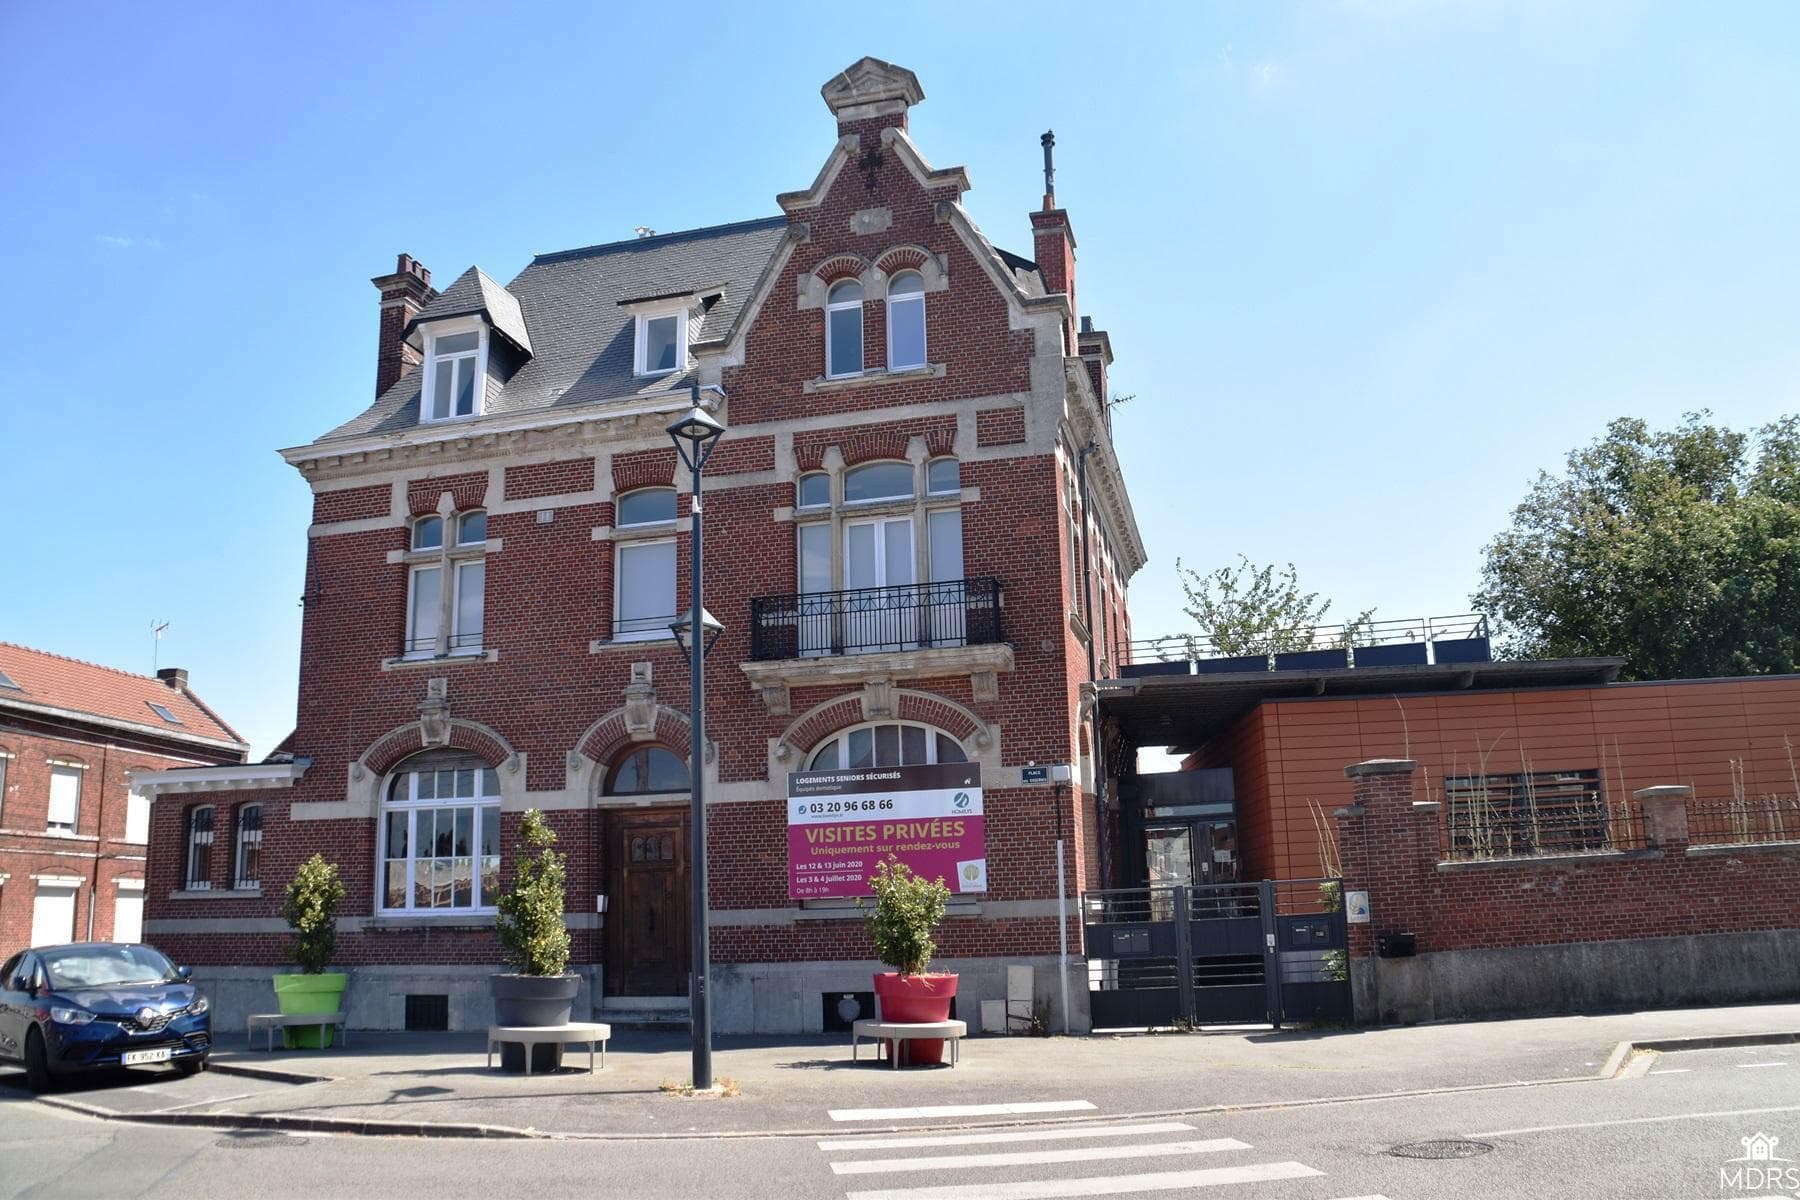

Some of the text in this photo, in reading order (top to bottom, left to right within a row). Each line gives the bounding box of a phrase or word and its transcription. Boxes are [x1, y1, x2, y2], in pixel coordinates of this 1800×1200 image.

[796, 772, 901, 784] LOGEMENTS SENIORS SÉCURISÉS
[810, 799, 893, 813] 03 20 96 68 66
[805, 818, 965, 844] VISITES PRIVÉES
[811, 841, 960, 857] Uniquement sur rendez-vous
[832, 861, 846, 870] juin
[825, 875, 845, 884] juillet
